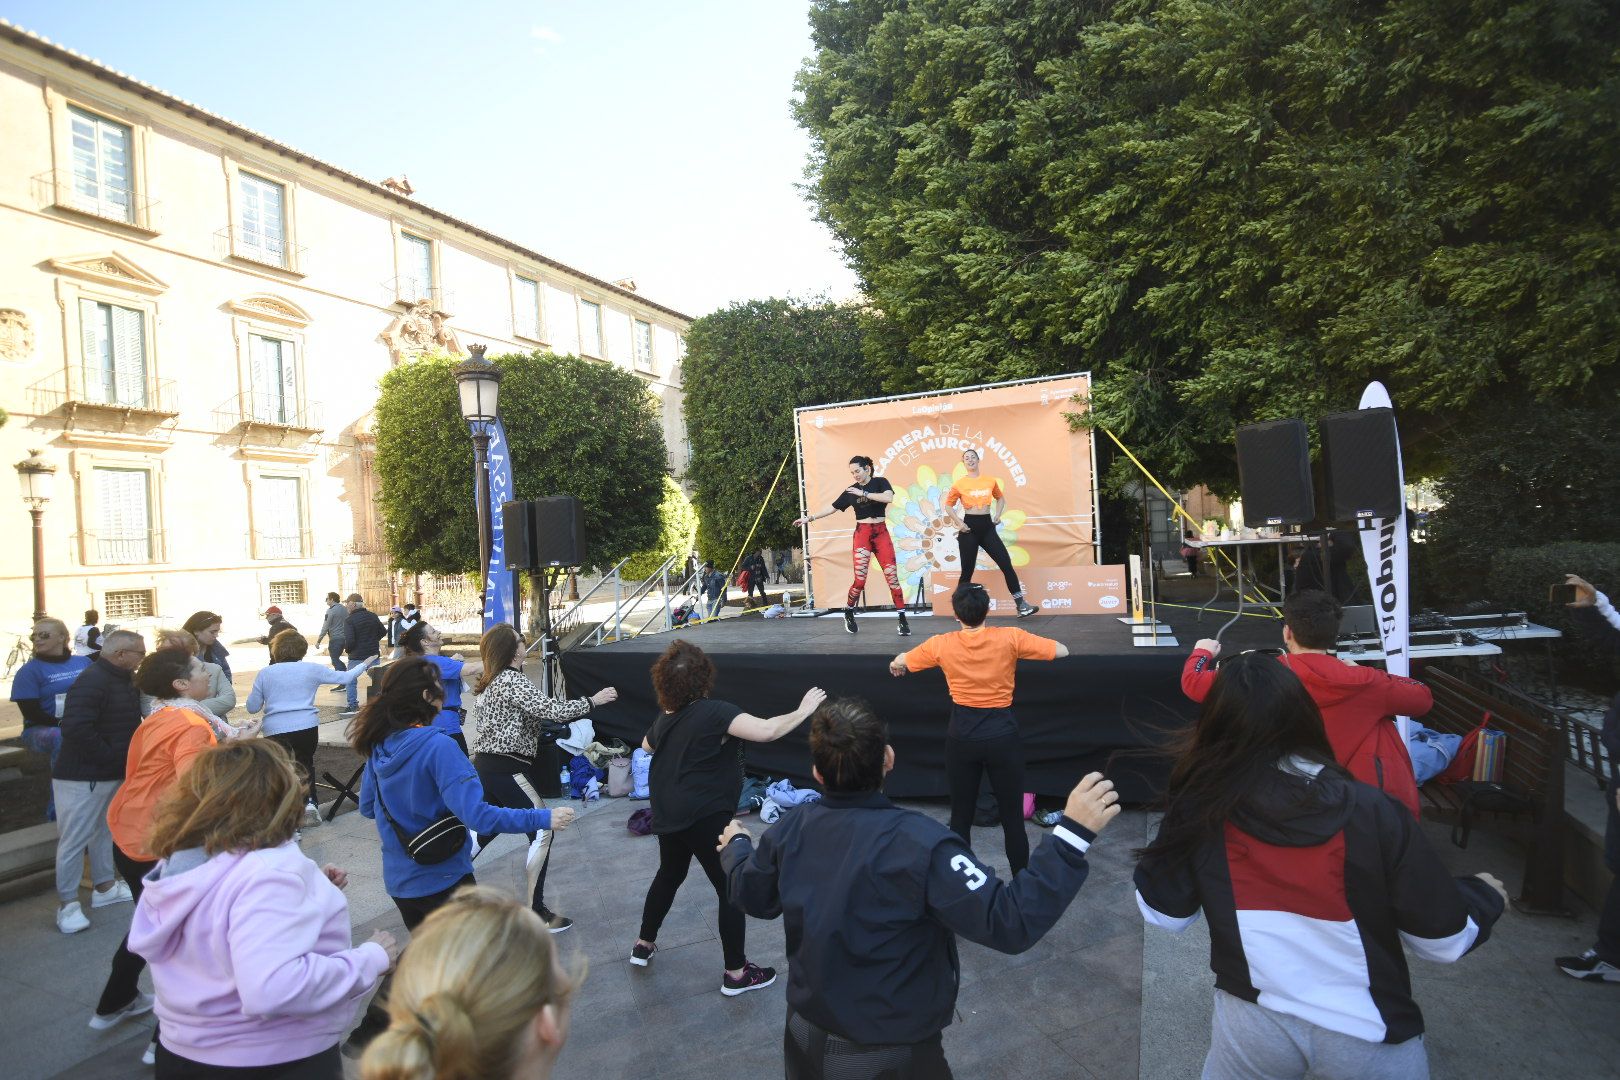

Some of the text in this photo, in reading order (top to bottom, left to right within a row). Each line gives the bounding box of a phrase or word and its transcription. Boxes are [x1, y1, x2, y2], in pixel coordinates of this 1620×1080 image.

[874, 424, 1027, 488] CARRERA DE LA MUJER
[898, 436, 985, 466] DE MURCIA
[951, 854, 987, 890] 3
